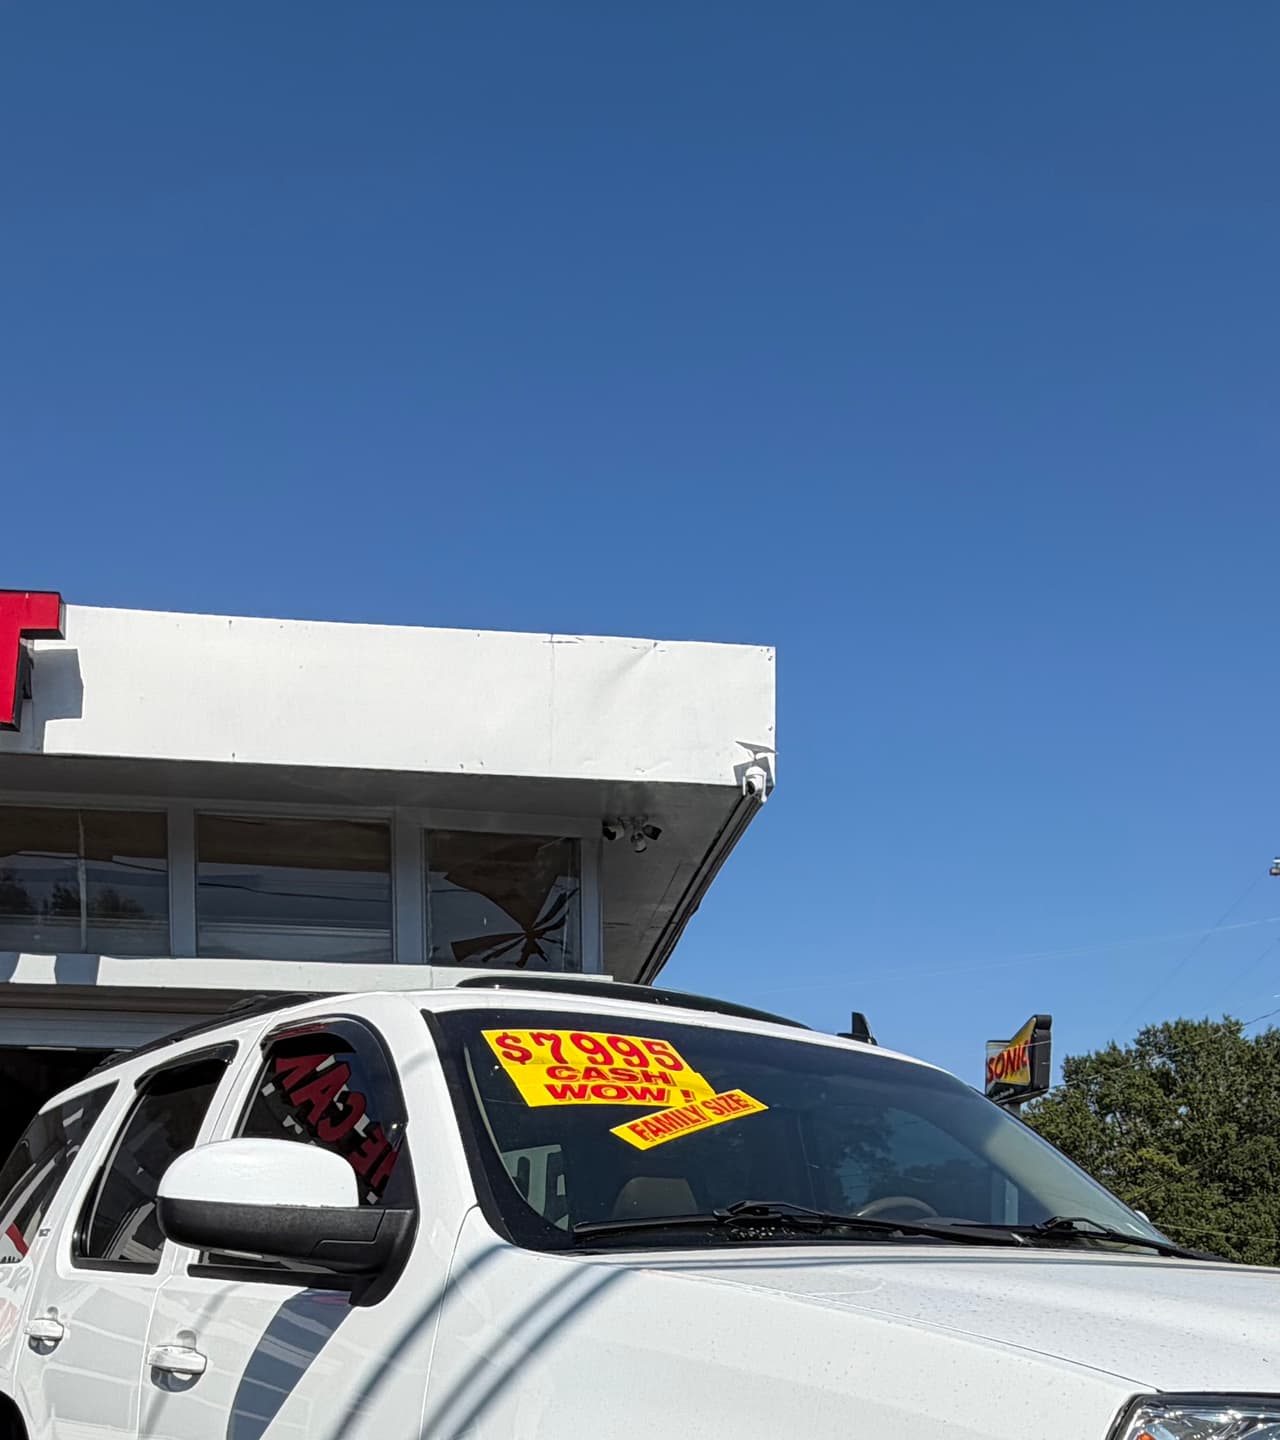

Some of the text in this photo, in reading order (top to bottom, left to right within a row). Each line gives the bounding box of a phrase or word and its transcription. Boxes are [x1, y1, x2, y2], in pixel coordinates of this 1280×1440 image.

[495, 1031, 683, 1072] $7995
[545, 1065, 674, 1086] CASH
[627, 1092, 754, 1142] FAMILY SIZE
